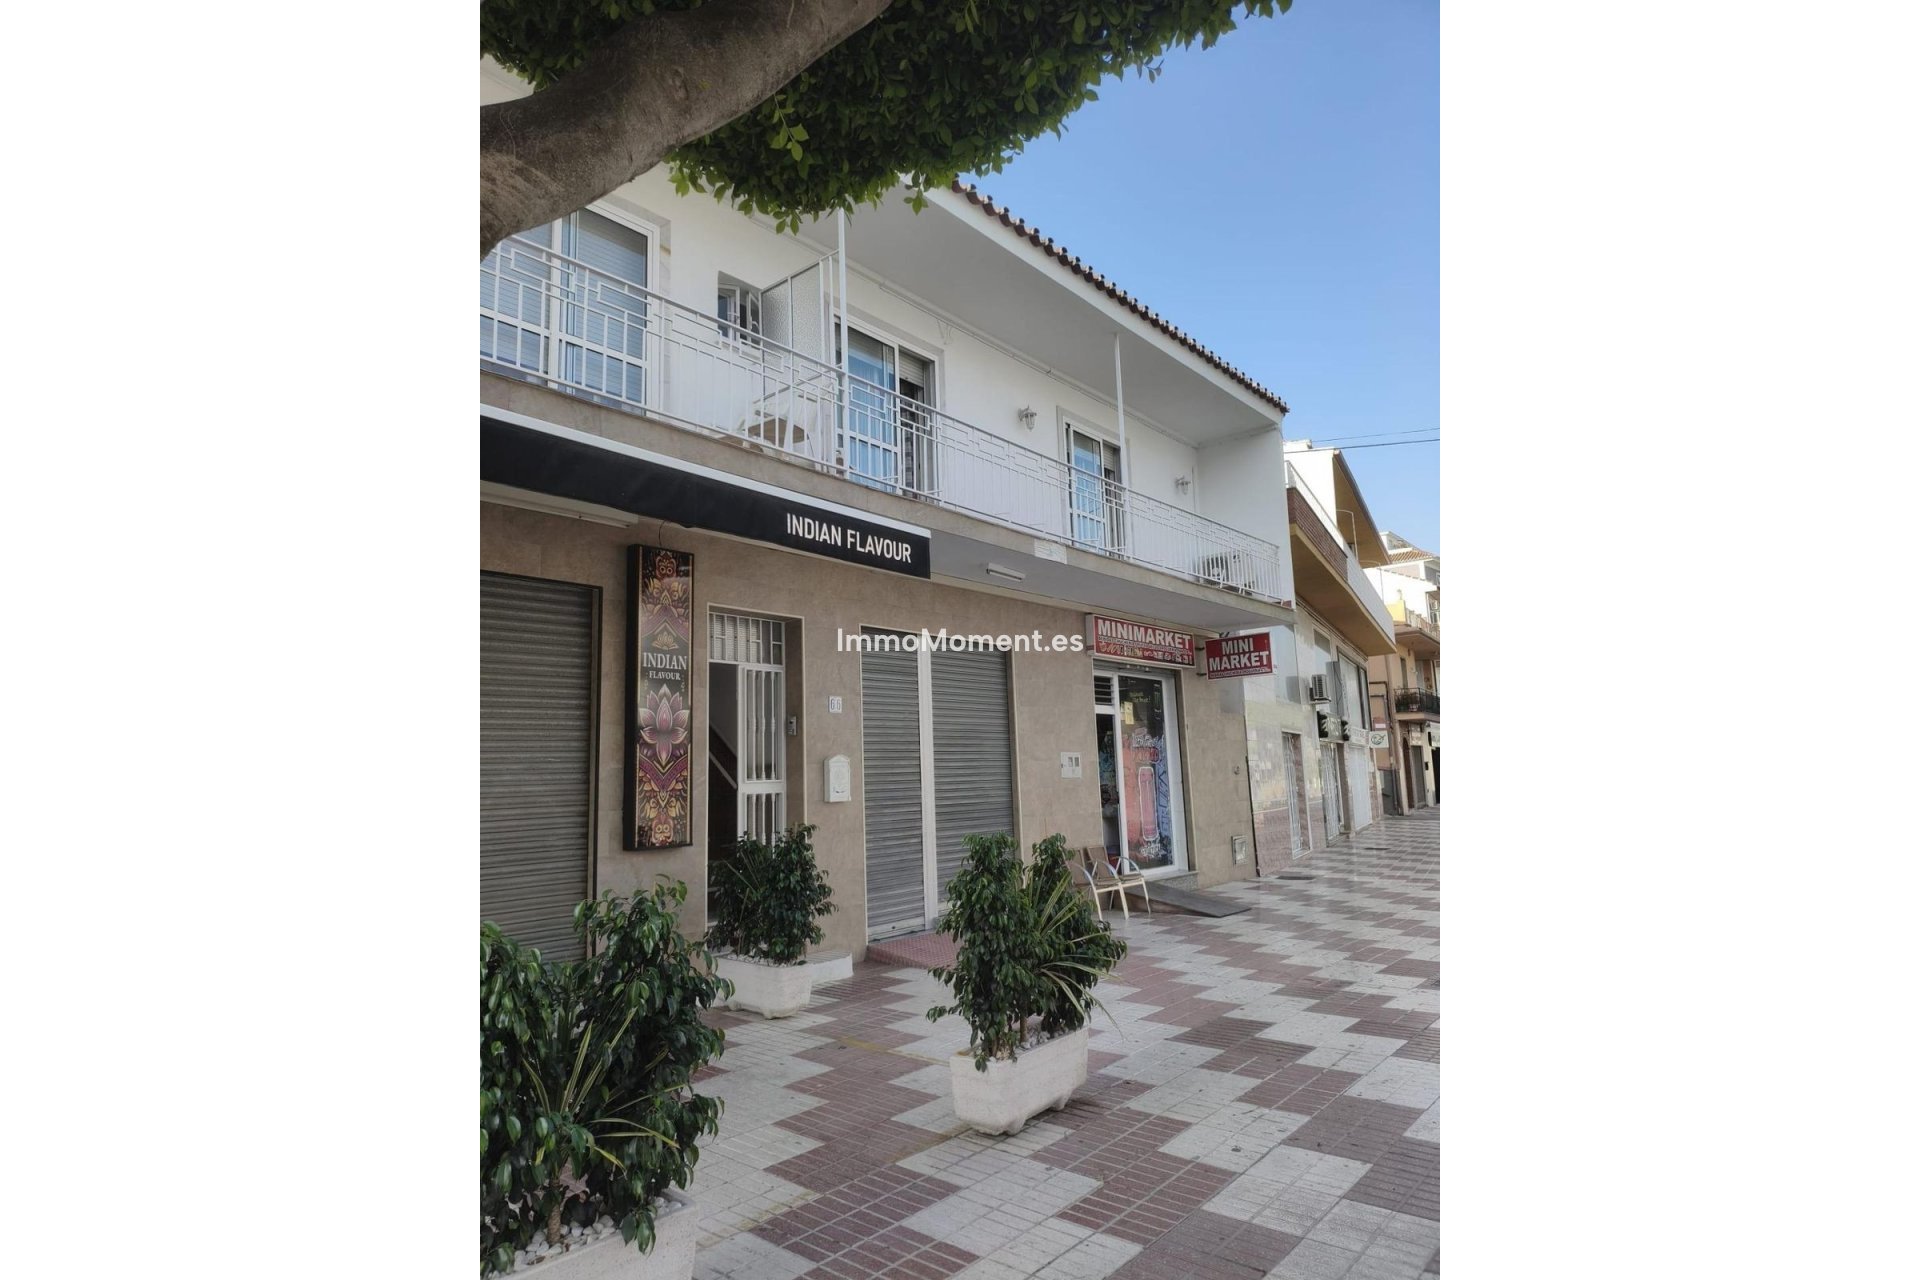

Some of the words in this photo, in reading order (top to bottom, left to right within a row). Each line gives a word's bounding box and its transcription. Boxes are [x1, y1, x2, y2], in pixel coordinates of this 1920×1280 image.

[786, 513, 842, 547] INDIAN
[847, 529, 912, 564] FLAVOUR
[1097, 619, 1192, 649] MINIMARKET
[1221, 637, 1254, 655] MINI
[642, 652, 687, 670] INDIAN
[1209, 651, 1270, 672] MARKET
[649, 670, 681, 681] FLAVOUR
